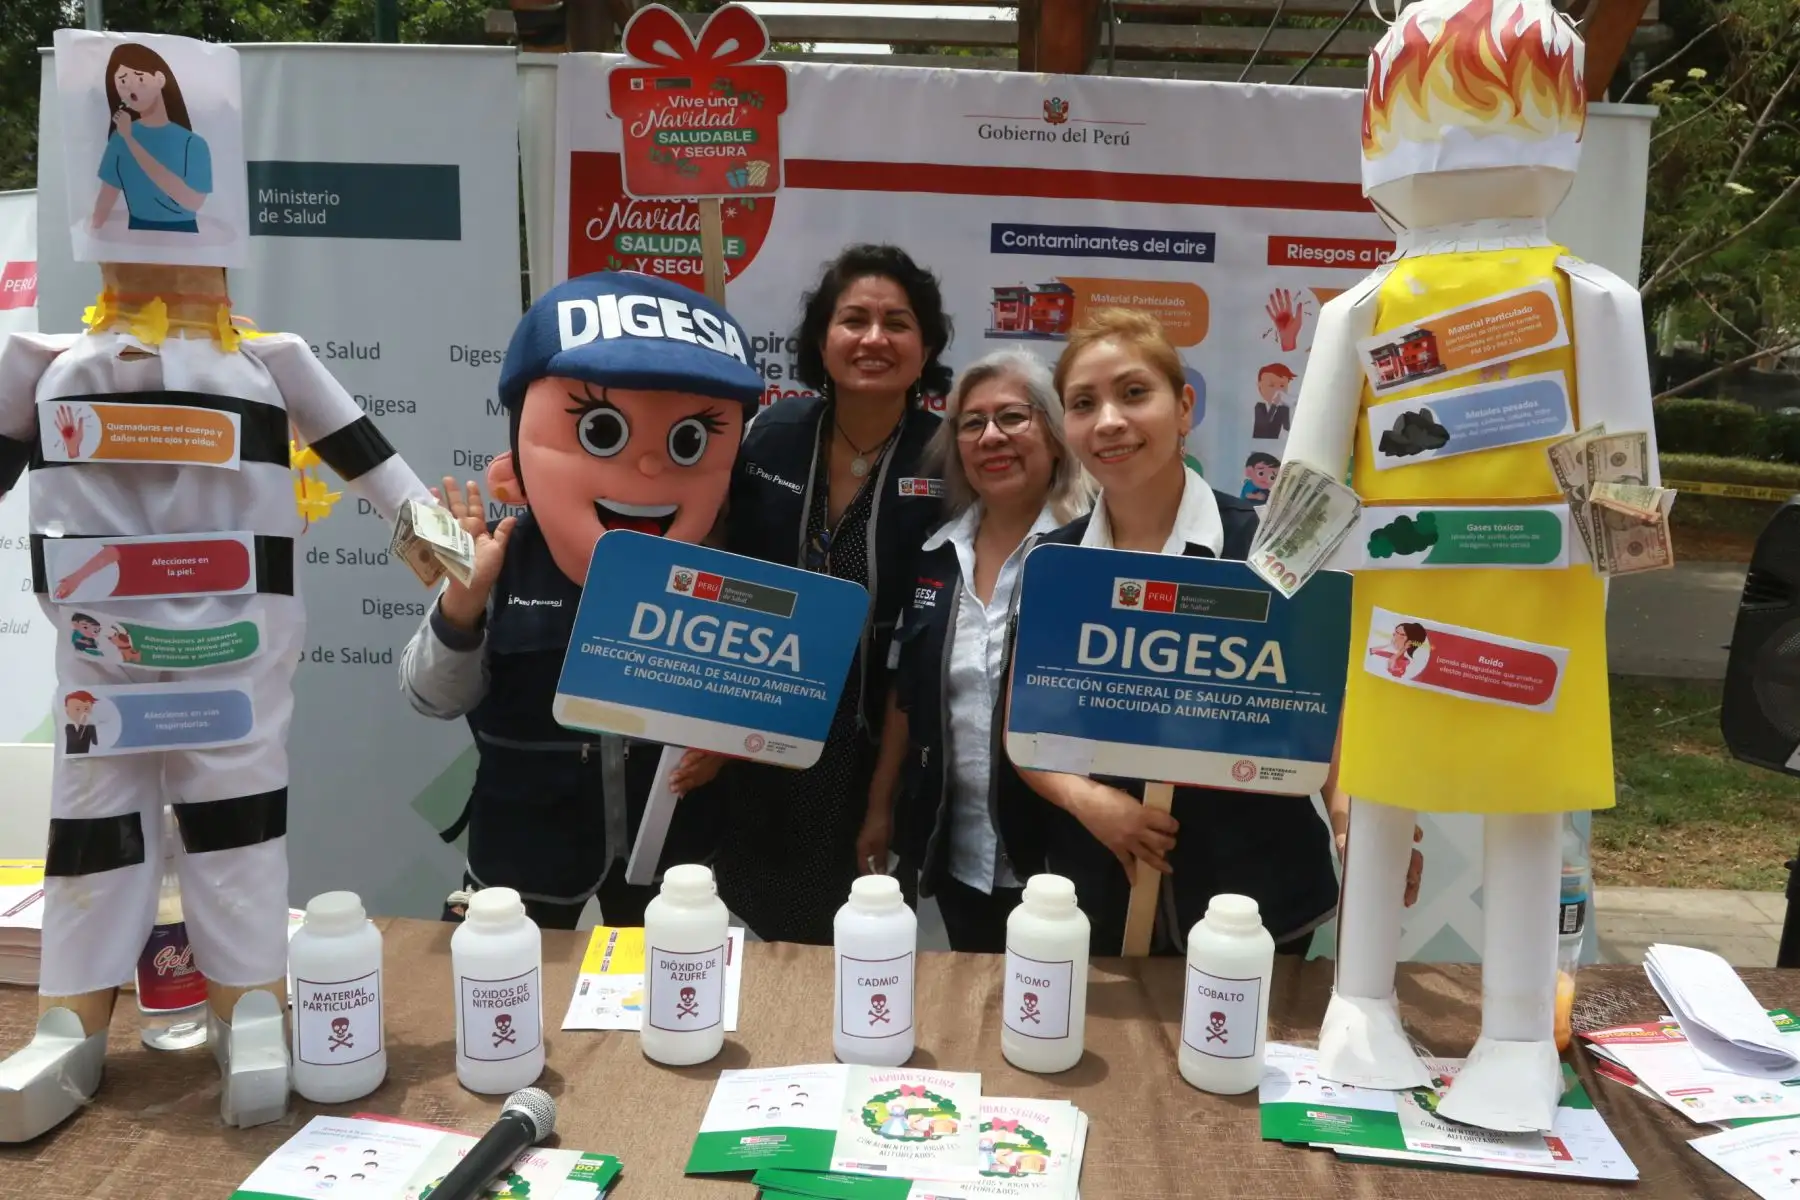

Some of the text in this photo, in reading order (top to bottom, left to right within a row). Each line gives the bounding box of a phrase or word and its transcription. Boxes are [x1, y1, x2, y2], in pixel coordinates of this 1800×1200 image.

[668, 96, 739, 108] Vive una
[630, 106, 740, 138] Navidad
[658, 130, 752, 143] SALUDABLE
[978, 123, 1130, 146] Gobierno del Perú
[671, 146, 747, 158] Y SEGURA
[258, 188, 340, 206] Ministerio
[258, 207, 326, 224] de Salud
[586, 200, 702, 241] Navida
[620, 235, 739, 255] SALUDAE
[1001, 230, 1206, 255] Contaminantes del aire
[1287, 243, 1355, 264] Riesgos
[1359, 250, 1371, 262] a
[635, 257, 731, 276] Y SEGUA
[4, 272, 37, 292] PERÚ
[1090, 293, 1186, 306] Material Particulado
[558, 294, 748, 365] DIGESA
[1447, 317, 1484, 336] Material
[1485, 305, 1533, 325] Particulado
[326, 340, 381, 360] Salud
[353, 394, 417, 417] Digesa
[1465, 400, 1539, 419] Metales pesados
[106, 422, 161, 432] Quemaduras
[185, 426, 215, 437] cuerpo
[216, 429, 224, 438] y
[138, 435, 149, 443] en
[150, 435, 163, 443] los
[165, 436, 183, 446] ojos
[1466, 523, 1492, 532] Gases
[151, 557, 197, 566] Afecciones
[306, 546, 389, 566] de Salud
[167, 568, 175, 576] la
[1262, 553, 1298, 589] 100
[362, 597, 425, 619] Digesa
[0, 617, 30, 634] alud
[629, 601, 802, 672] DIGESA
[312, 645, 393, 664] de Salud
[1076, 622, 1288, 685] DIGESA
[1478, 655, 1504, 668] Ruido
[580, 642, 828, 701] DIRECCIÓN GENERAL DE SALUD AMBIENTAL
[624, 665, 783, 706] E INOCUIDAD ALIMENTARIA
[1026, 674, 1329, 715] DIRECCIÓN GENERAL DE SALUD AMBIENTAL
[1078, 696, 1271, 725] E INOCUIDAD ALIMENTARIA
[660, 957, 717, 972] DIÓXIDO DE
[670, 970, 708, 982] AZUFRE
[857, 974, 899, 988] CADMIO
[1014, 971, 1051, 989] PLOMO
[312, 985, 367, 1002] MATERIAL
[472, 982, 529, 1000] ÓXIDOS DE
[1197, 985, 1245, 1003] COBALTO
[302, 992, 376, 1013] PARTICULADO
[472, 993, 531, 1009] NITRÓGENO
[869, 1071, 956, 1089] NAVIDAD SEGURA
[1010, 1106, 1051, 1124] SEGURA
[1420, 1119, 1436, 1129] CON
